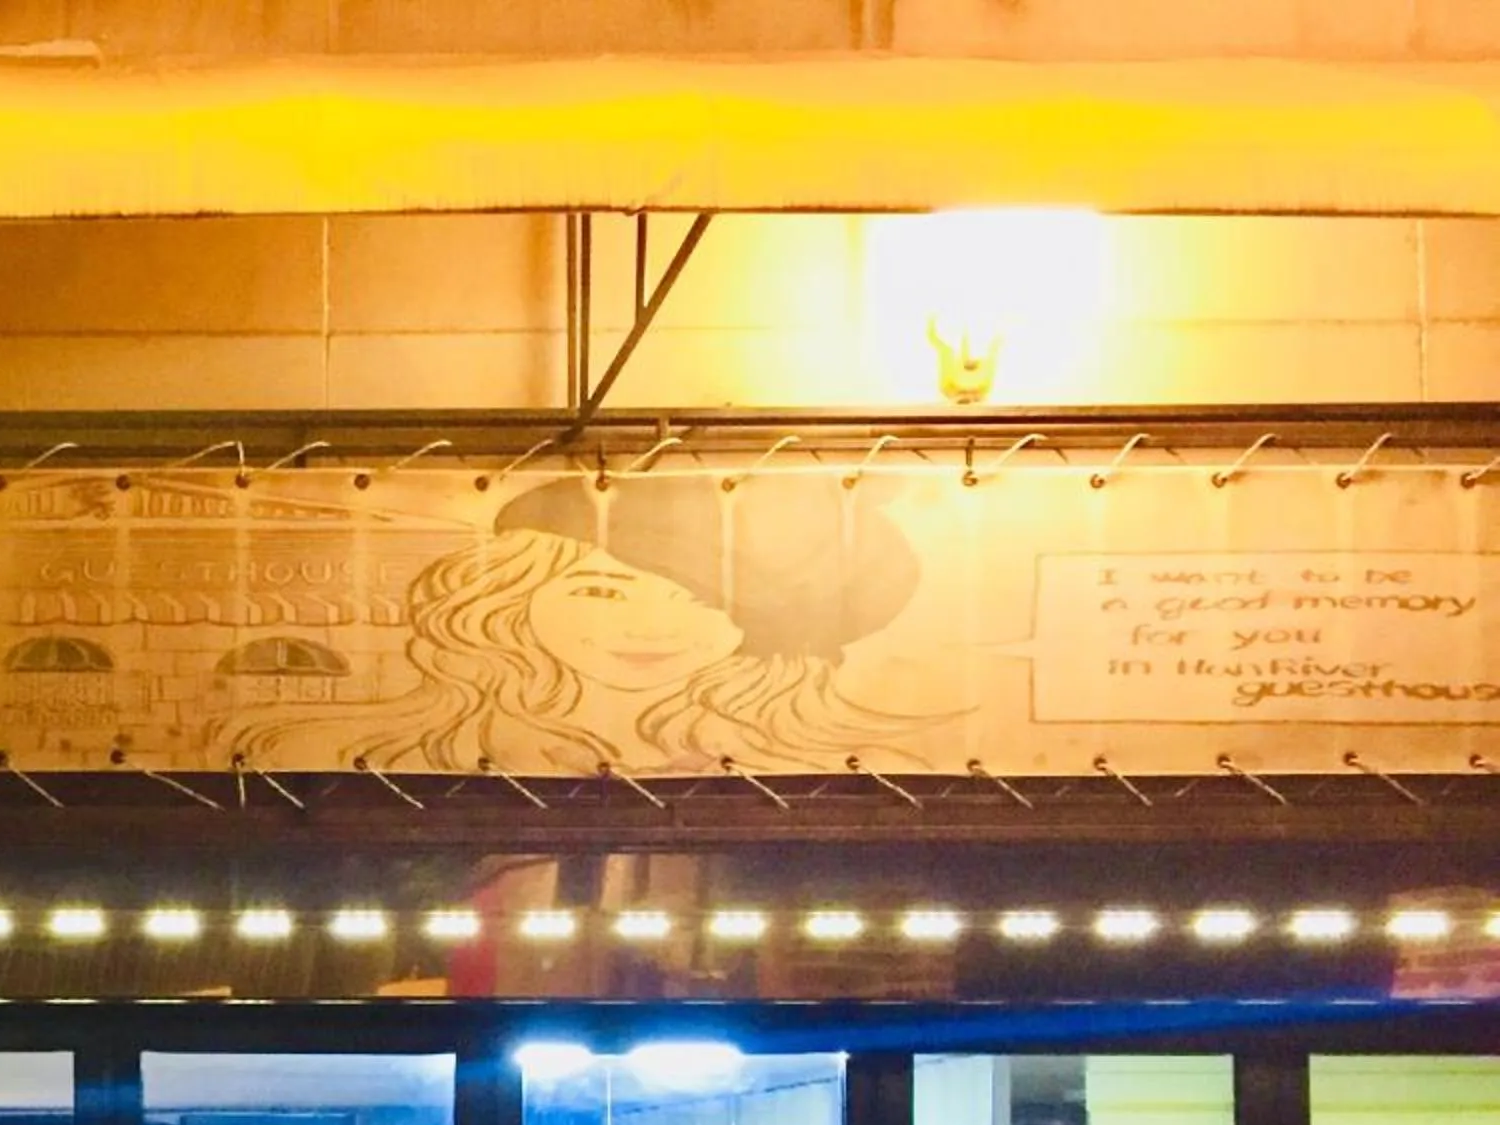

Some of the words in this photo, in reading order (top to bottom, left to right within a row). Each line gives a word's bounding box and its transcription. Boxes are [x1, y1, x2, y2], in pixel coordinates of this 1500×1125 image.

[39, 559, 409, 585] GUSTHOUSE
[1301, 569, 1341, 586] to
[1292, 594, 1477, 619] memory
[1131, 622, 1196, 646] for
[1229, 629, 1321, 652] you
[1107, 658, 1153, 677] in
